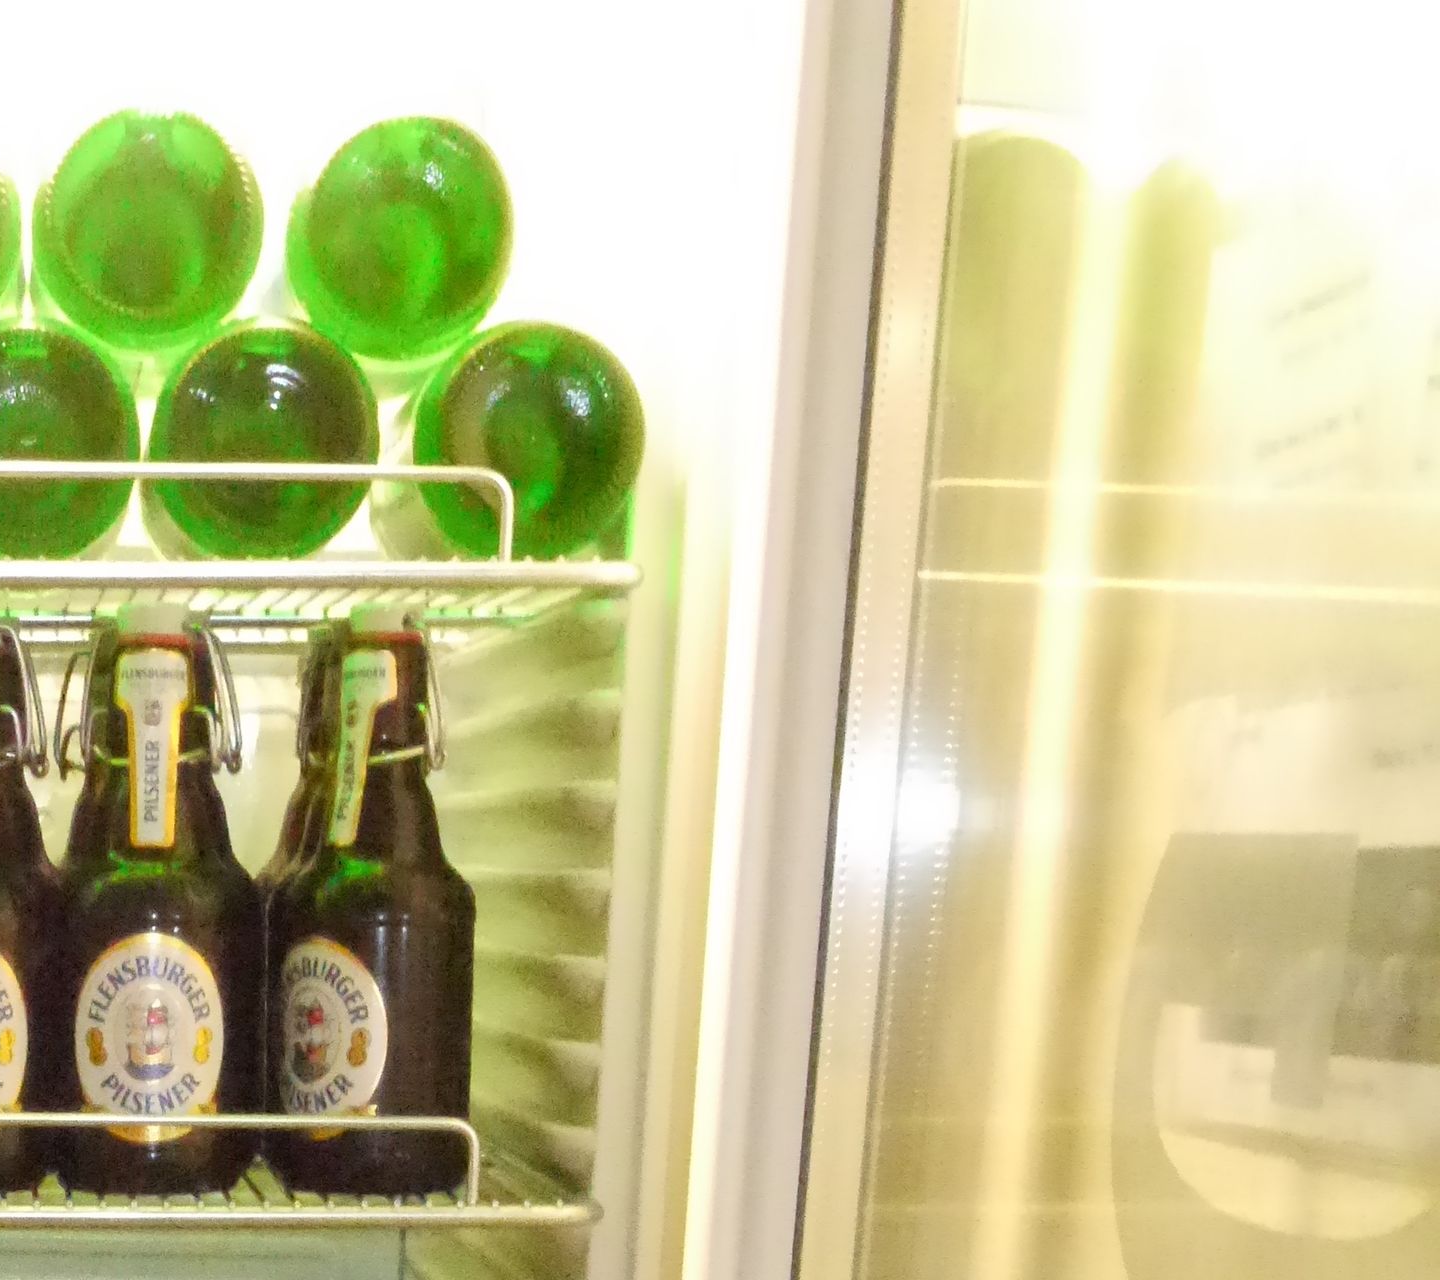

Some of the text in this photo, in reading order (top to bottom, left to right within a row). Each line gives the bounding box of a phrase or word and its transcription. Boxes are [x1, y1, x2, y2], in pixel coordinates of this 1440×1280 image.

[143, 739, 162, 823] PILSENER
[87, 955, 212, 1025] FLENSBURGER
[100, 1073, 200, 1115] PILSENER
